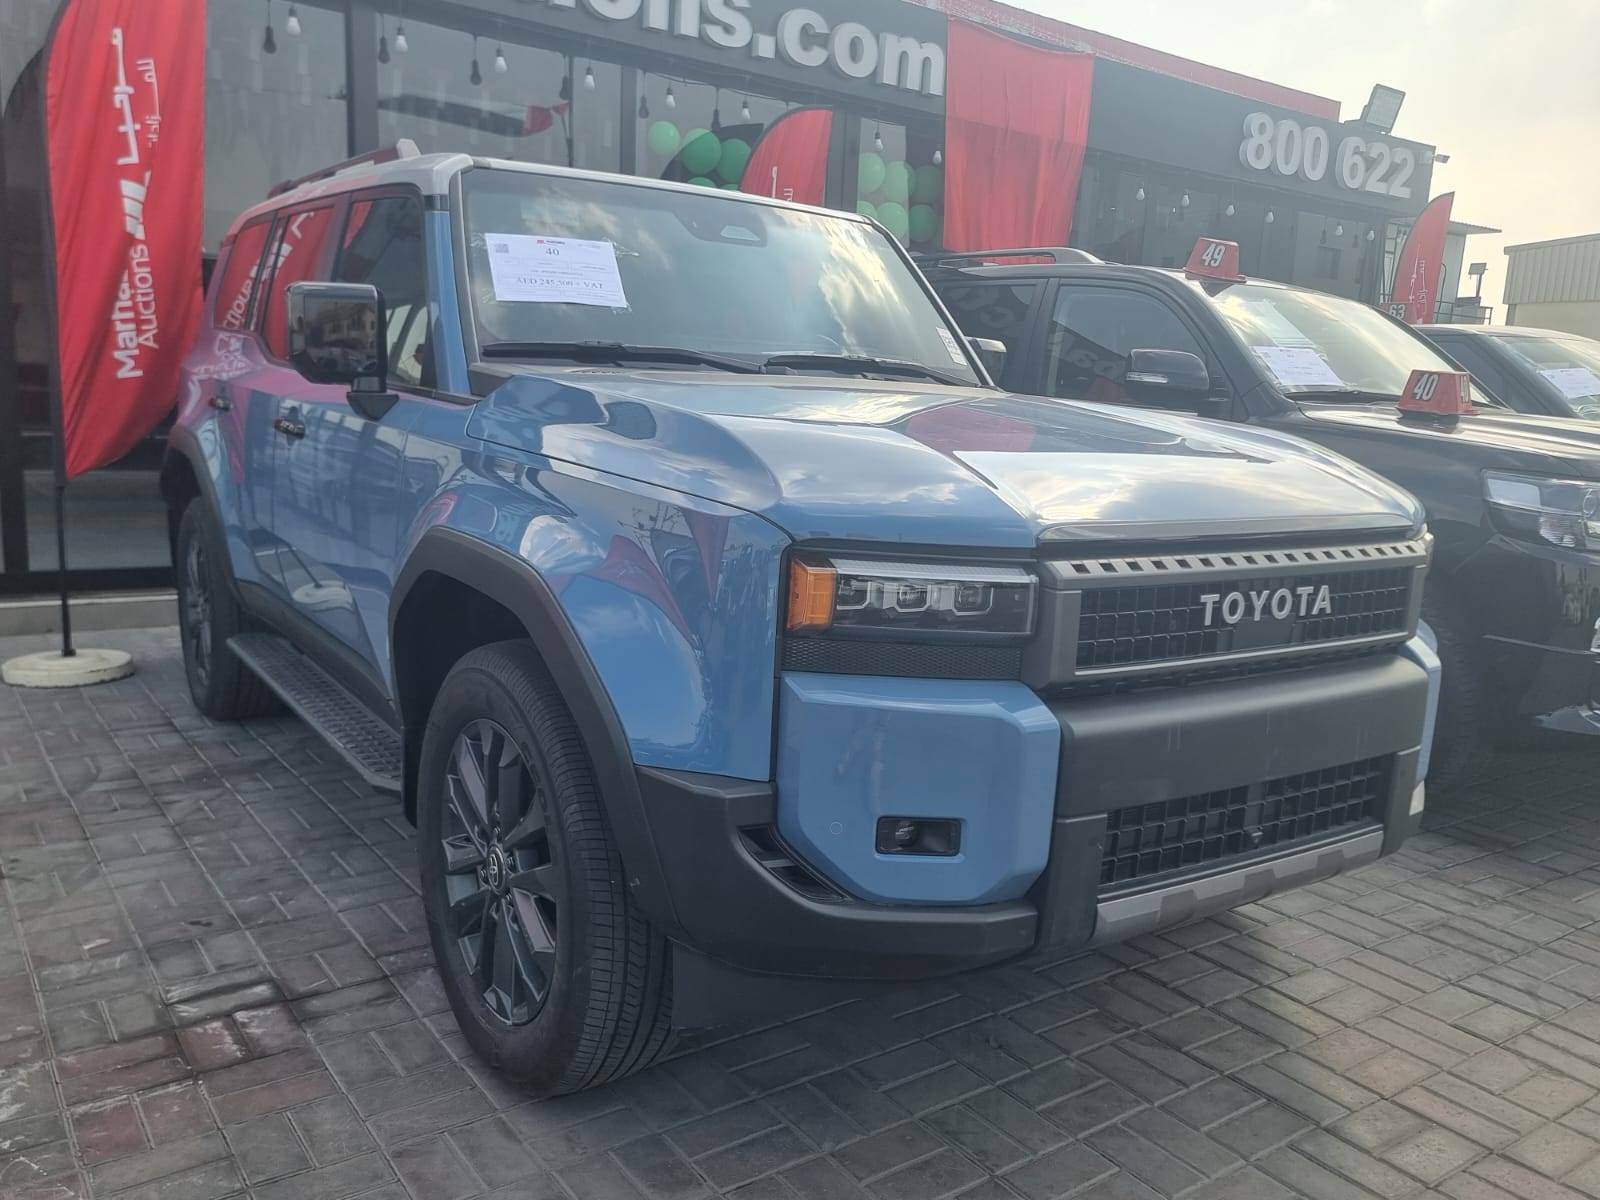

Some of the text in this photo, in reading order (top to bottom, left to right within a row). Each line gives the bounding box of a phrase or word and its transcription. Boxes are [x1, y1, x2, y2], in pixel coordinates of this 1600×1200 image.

[1239, 111, 1415, 199] 800 622
[1201, 243, 1226, 268] 49
[111, 269, 144, 379] Marha
[129, 243, 160, 350] Auctions
[1413, 373, 1440, 401] 40
[1200, 584, 1332, 627] TOYOTA
